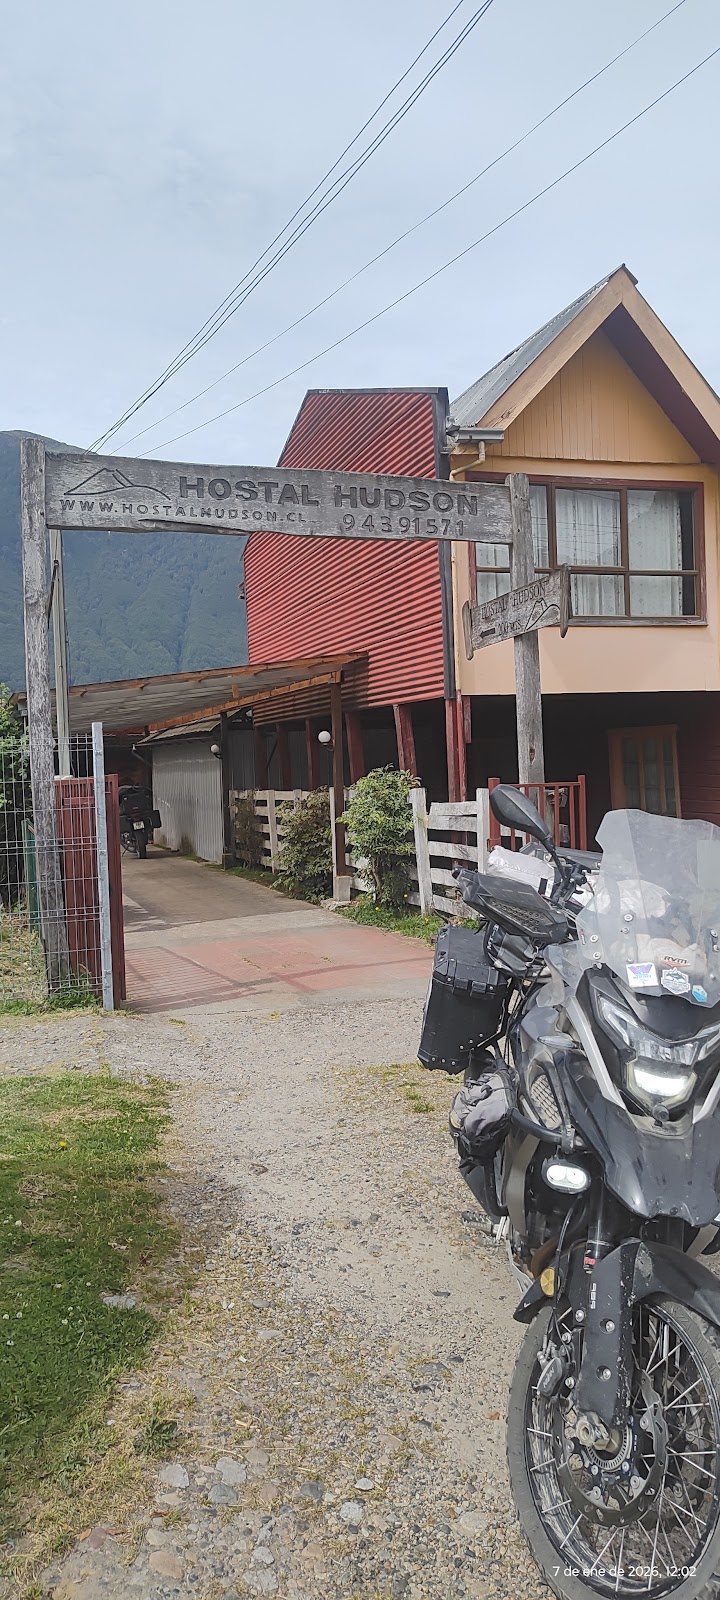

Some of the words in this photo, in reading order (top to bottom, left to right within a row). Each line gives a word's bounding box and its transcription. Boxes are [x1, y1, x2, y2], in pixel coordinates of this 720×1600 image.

[59, 500, 307, 523] WWW.HOSTALHUDSON.CL
[179, 476, 320, 507] HOSTAL
[334, 485, 478, 516] HUDSON
